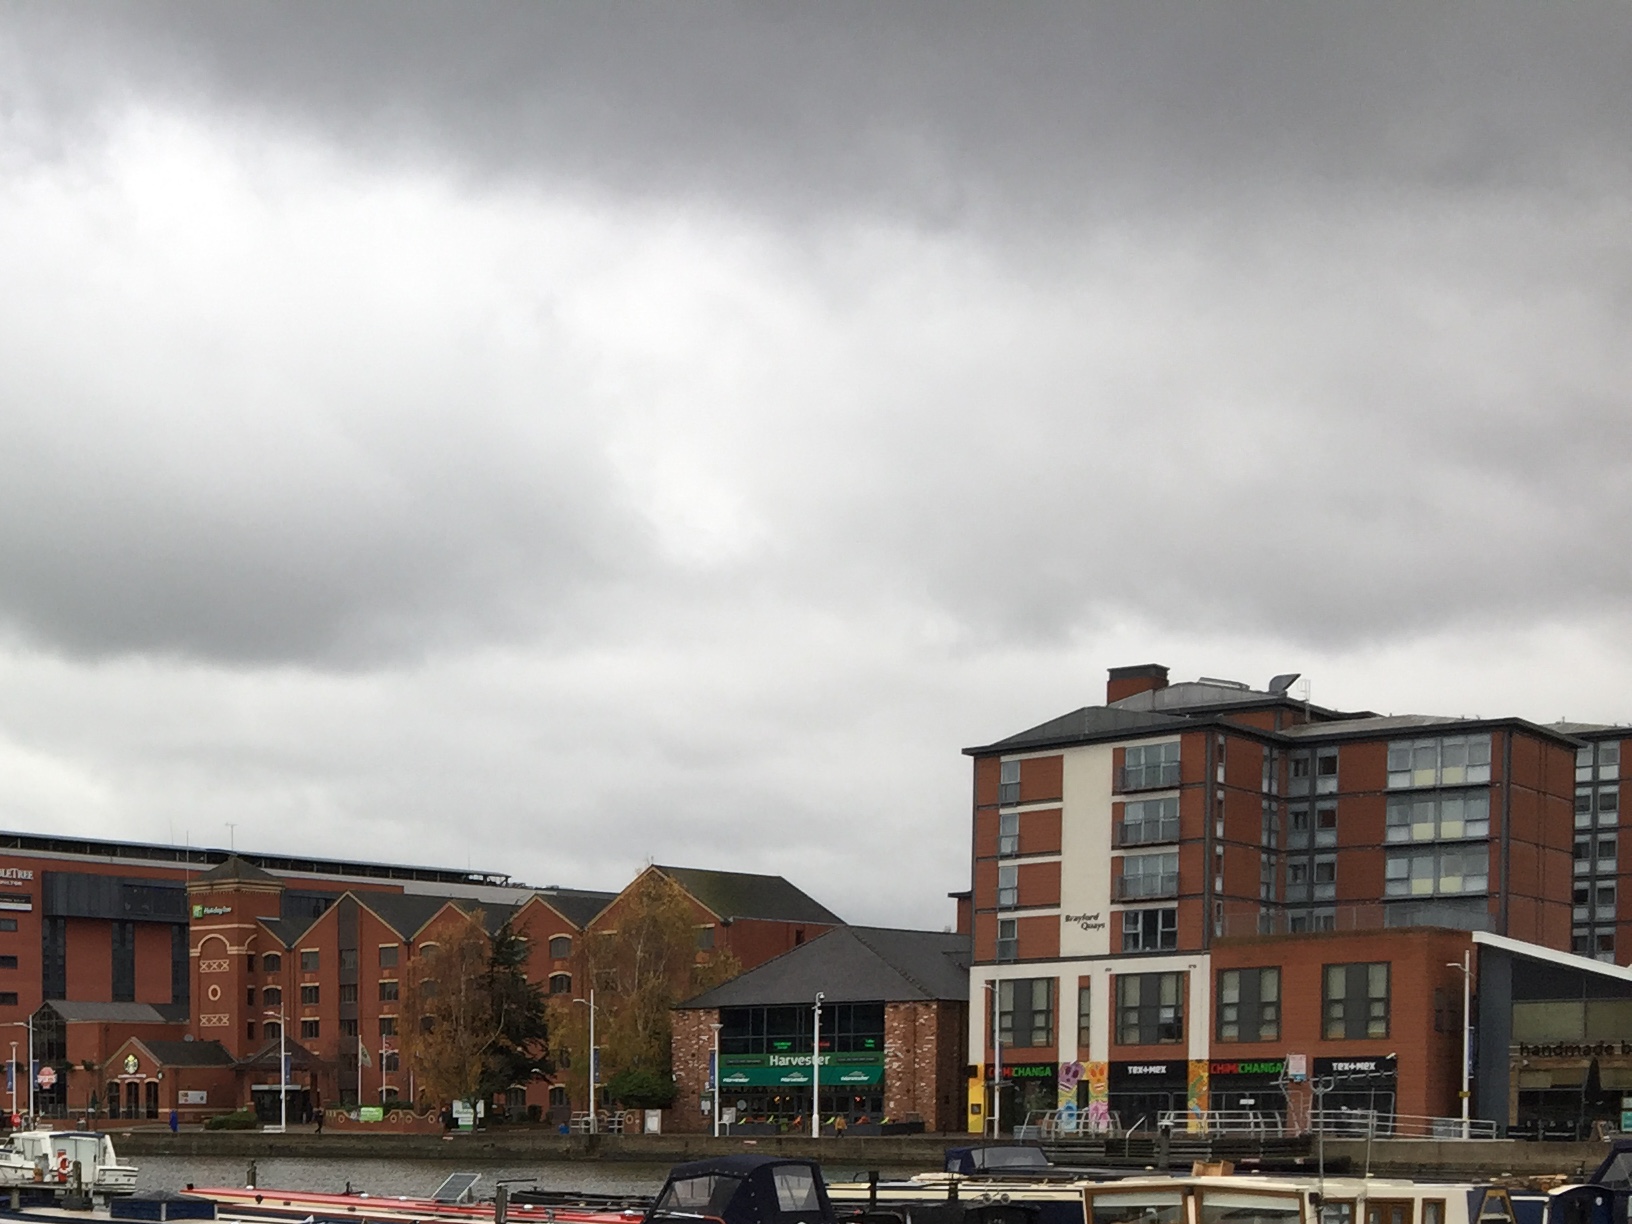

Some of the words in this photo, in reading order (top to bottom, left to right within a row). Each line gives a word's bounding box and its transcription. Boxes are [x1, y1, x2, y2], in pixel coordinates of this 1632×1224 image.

[1065, 913, 1099, 924] Brayford
[1081, 922, 1105, 931] Quays
[1519, 1041, 1615, 1056] handmade
[988, 1066, 1052, 1078] CMICHANGA
